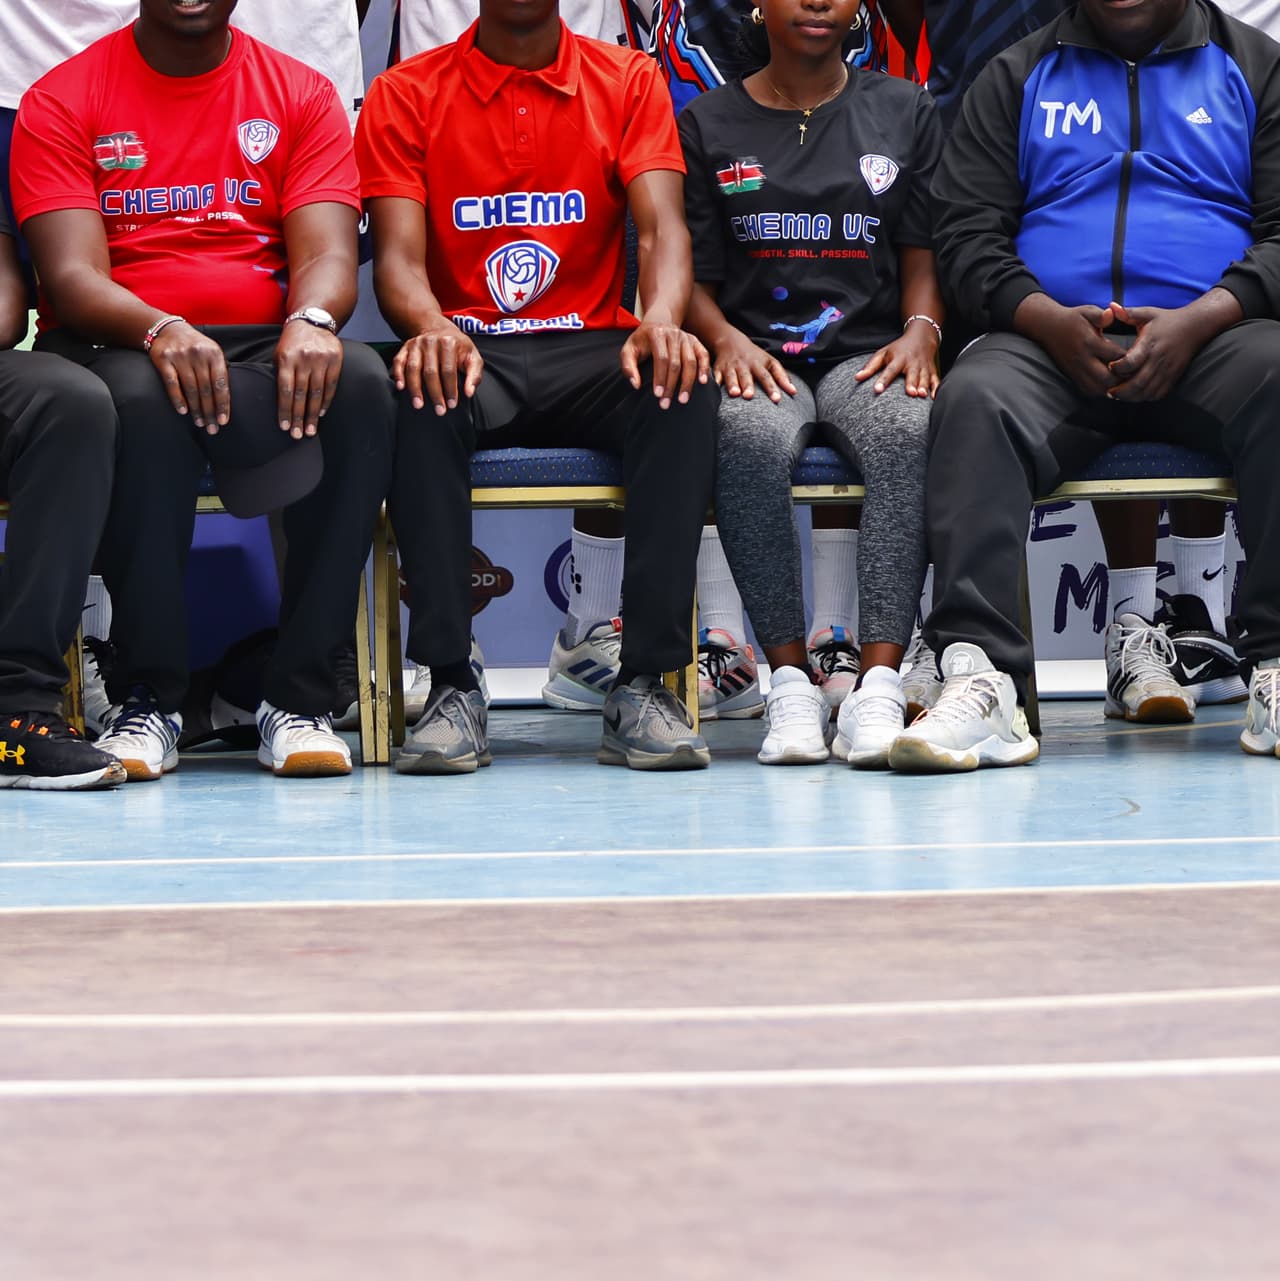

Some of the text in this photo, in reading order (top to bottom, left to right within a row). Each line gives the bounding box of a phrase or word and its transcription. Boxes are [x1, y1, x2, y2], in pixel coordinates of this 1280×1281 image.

[1040, 97, 1102, 139] TM
[100, 177, 262, 216] CHEMA VC
[452, 188, 586, 231] CHEMA
[730, 212, 881, 244] CHEMA VC
[788, 249, 818, 258] SKILL.
[453, 311, 584, 336] VOLLEYBALL
